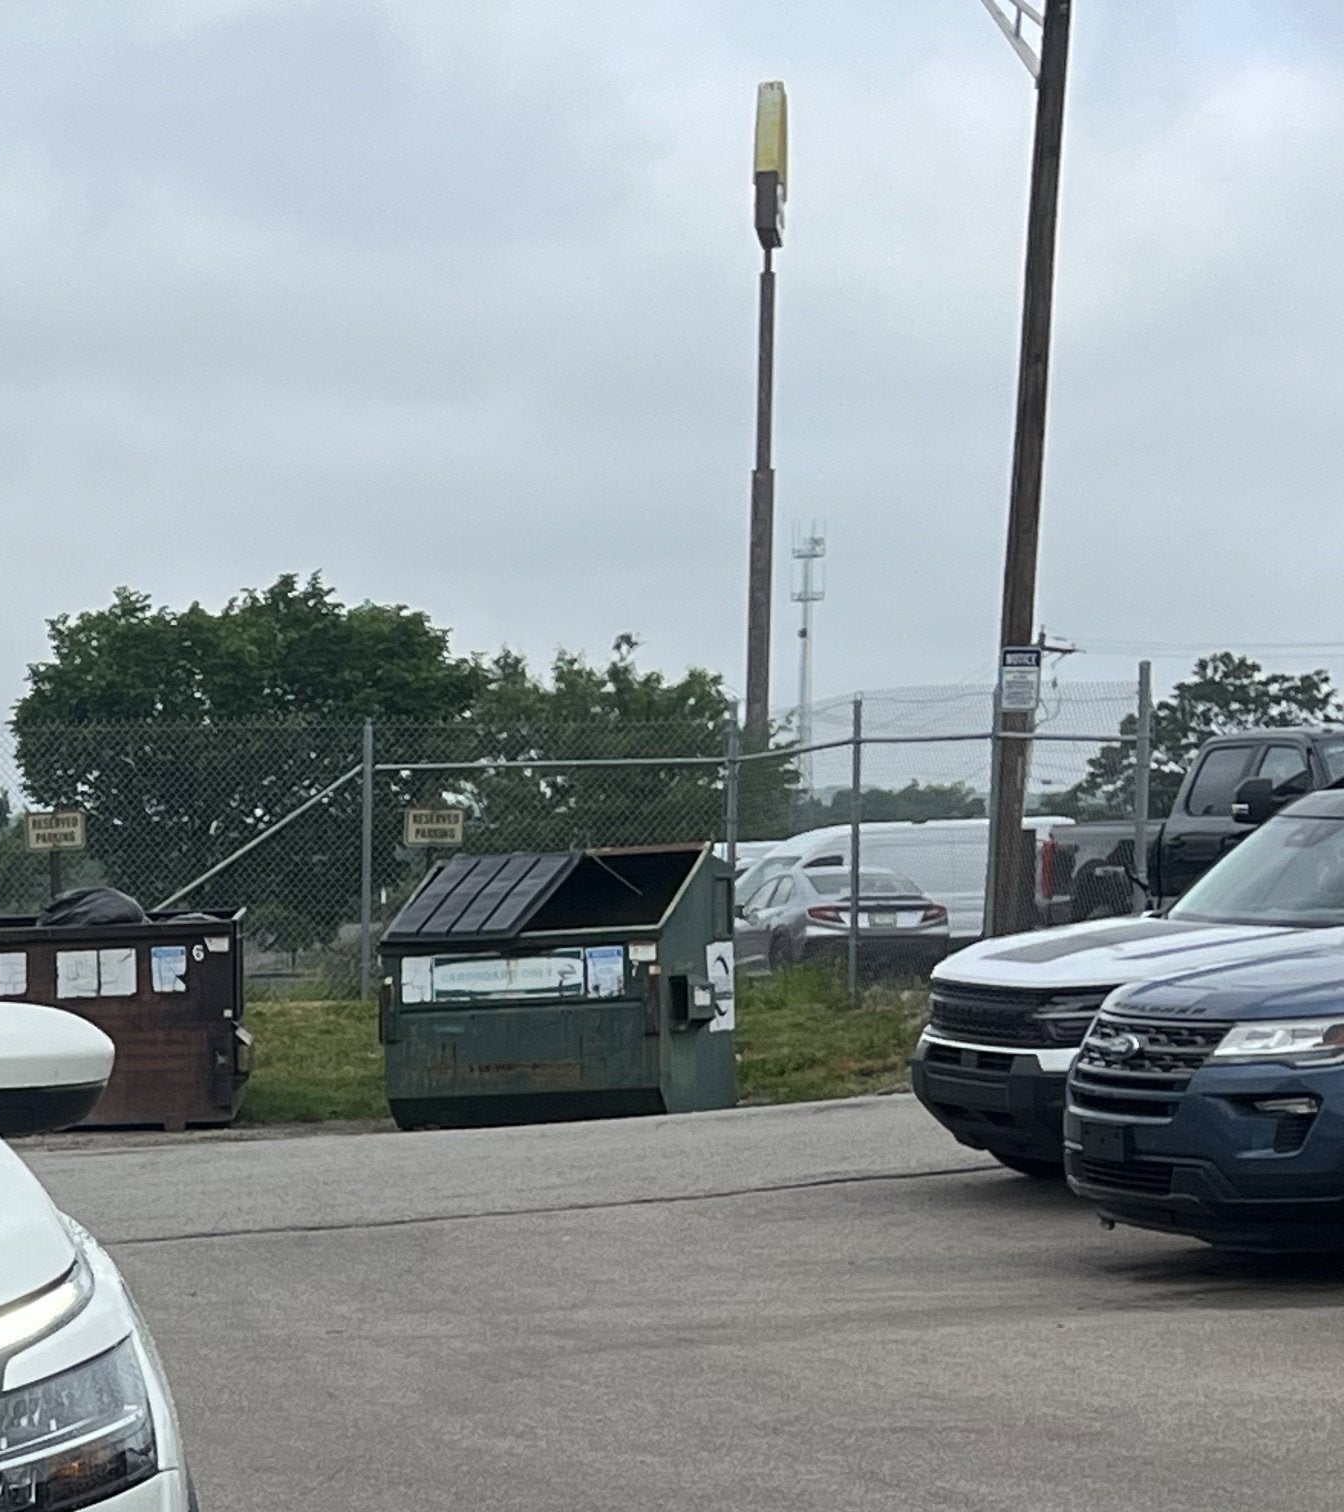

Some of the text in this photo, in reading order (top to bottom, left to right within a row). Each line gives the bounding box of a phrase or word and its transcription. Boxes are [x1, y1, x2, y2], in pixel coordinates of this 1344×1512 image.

[32, 816, 79, 829] RESERVED
[412, 813, 460, 825] RESERVED
[35, 831, 75, 844] PARKING
[415, 827, 456, 839] PARKING
[192, 944, 204, 962] 6
